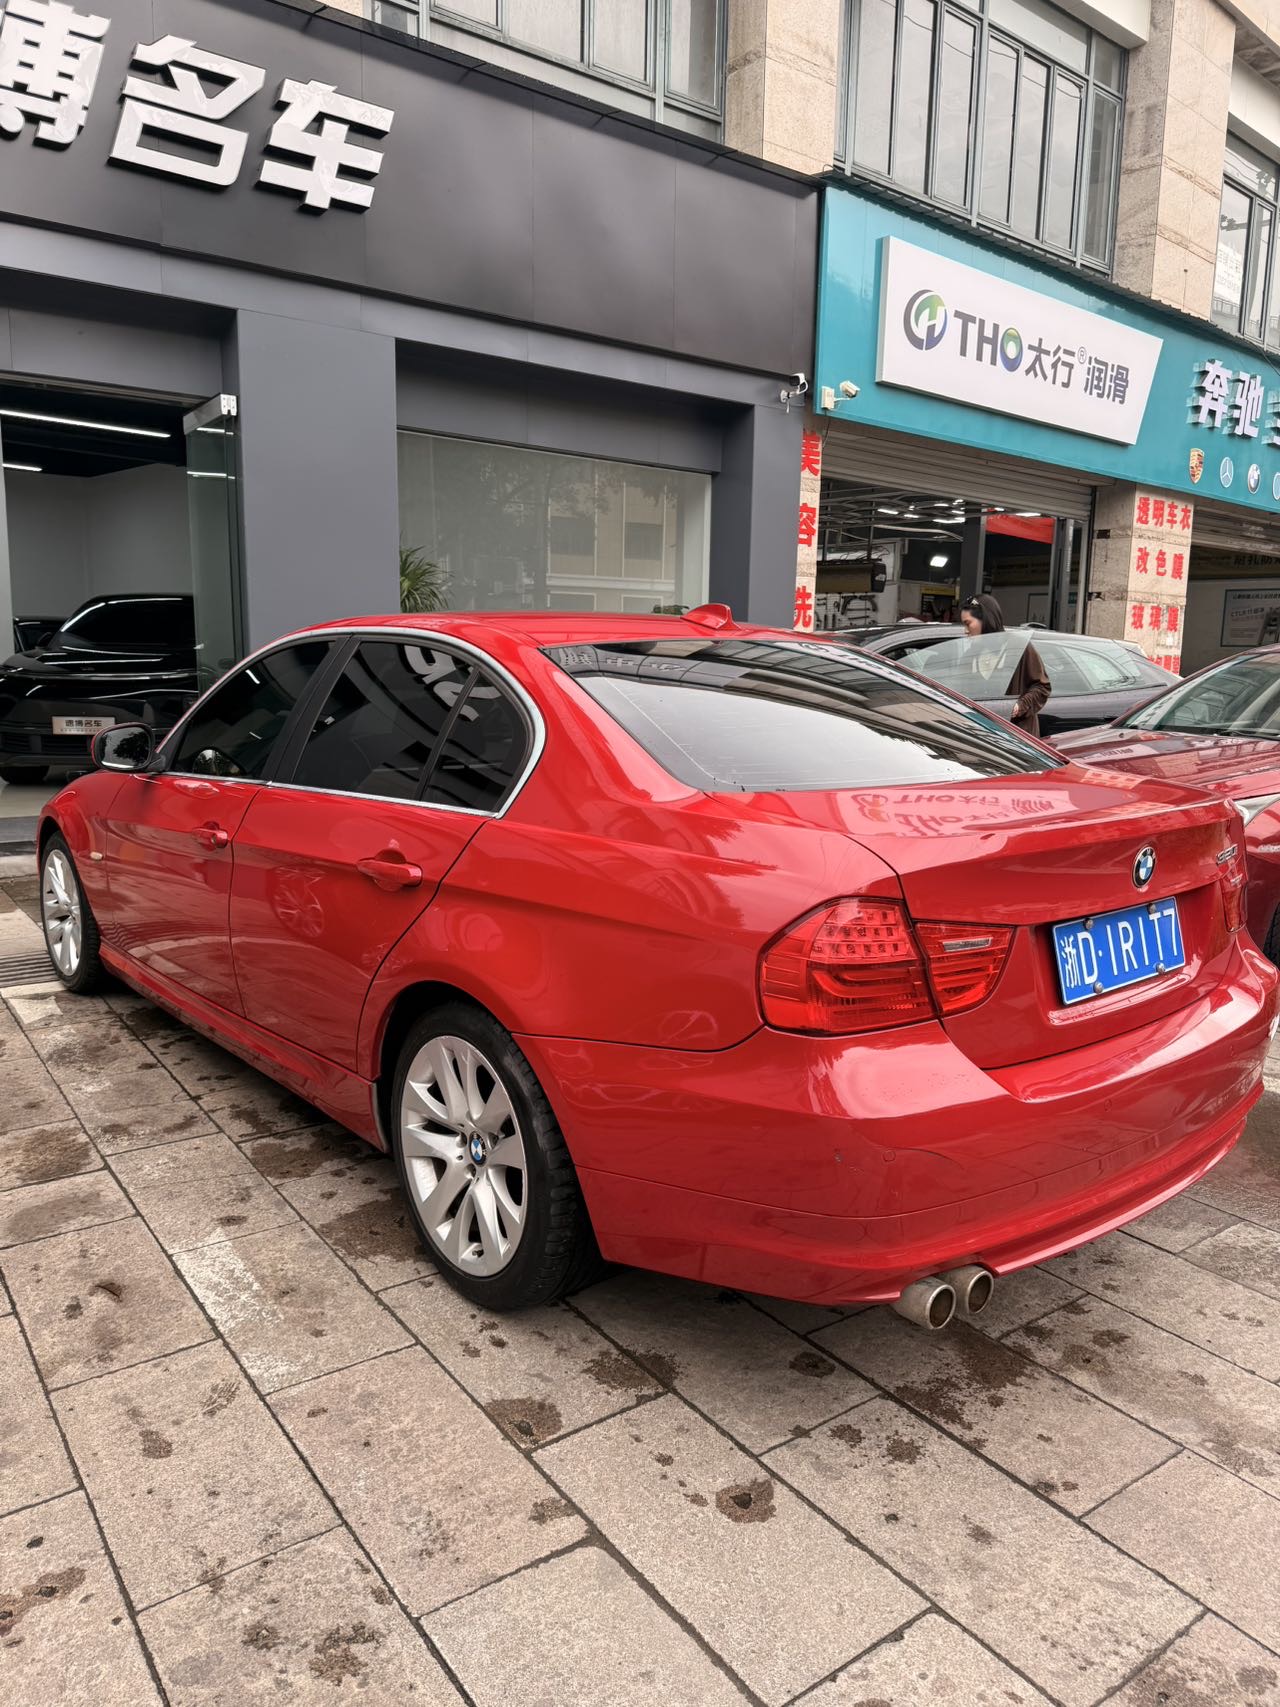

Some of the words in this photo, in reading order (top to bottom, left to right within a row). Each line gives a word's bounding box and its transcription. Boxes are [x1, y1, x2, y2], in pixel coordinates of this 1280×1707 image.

[953, 309, 1024, 372] THO
[1198, 359, 1280, 446] 奔驰
[1136, 496, 1192, 531] 透明车衣
[1135, 546, 1185, 581] 改色膜
[1131, 602, 1180, 633] 玻璃膜
